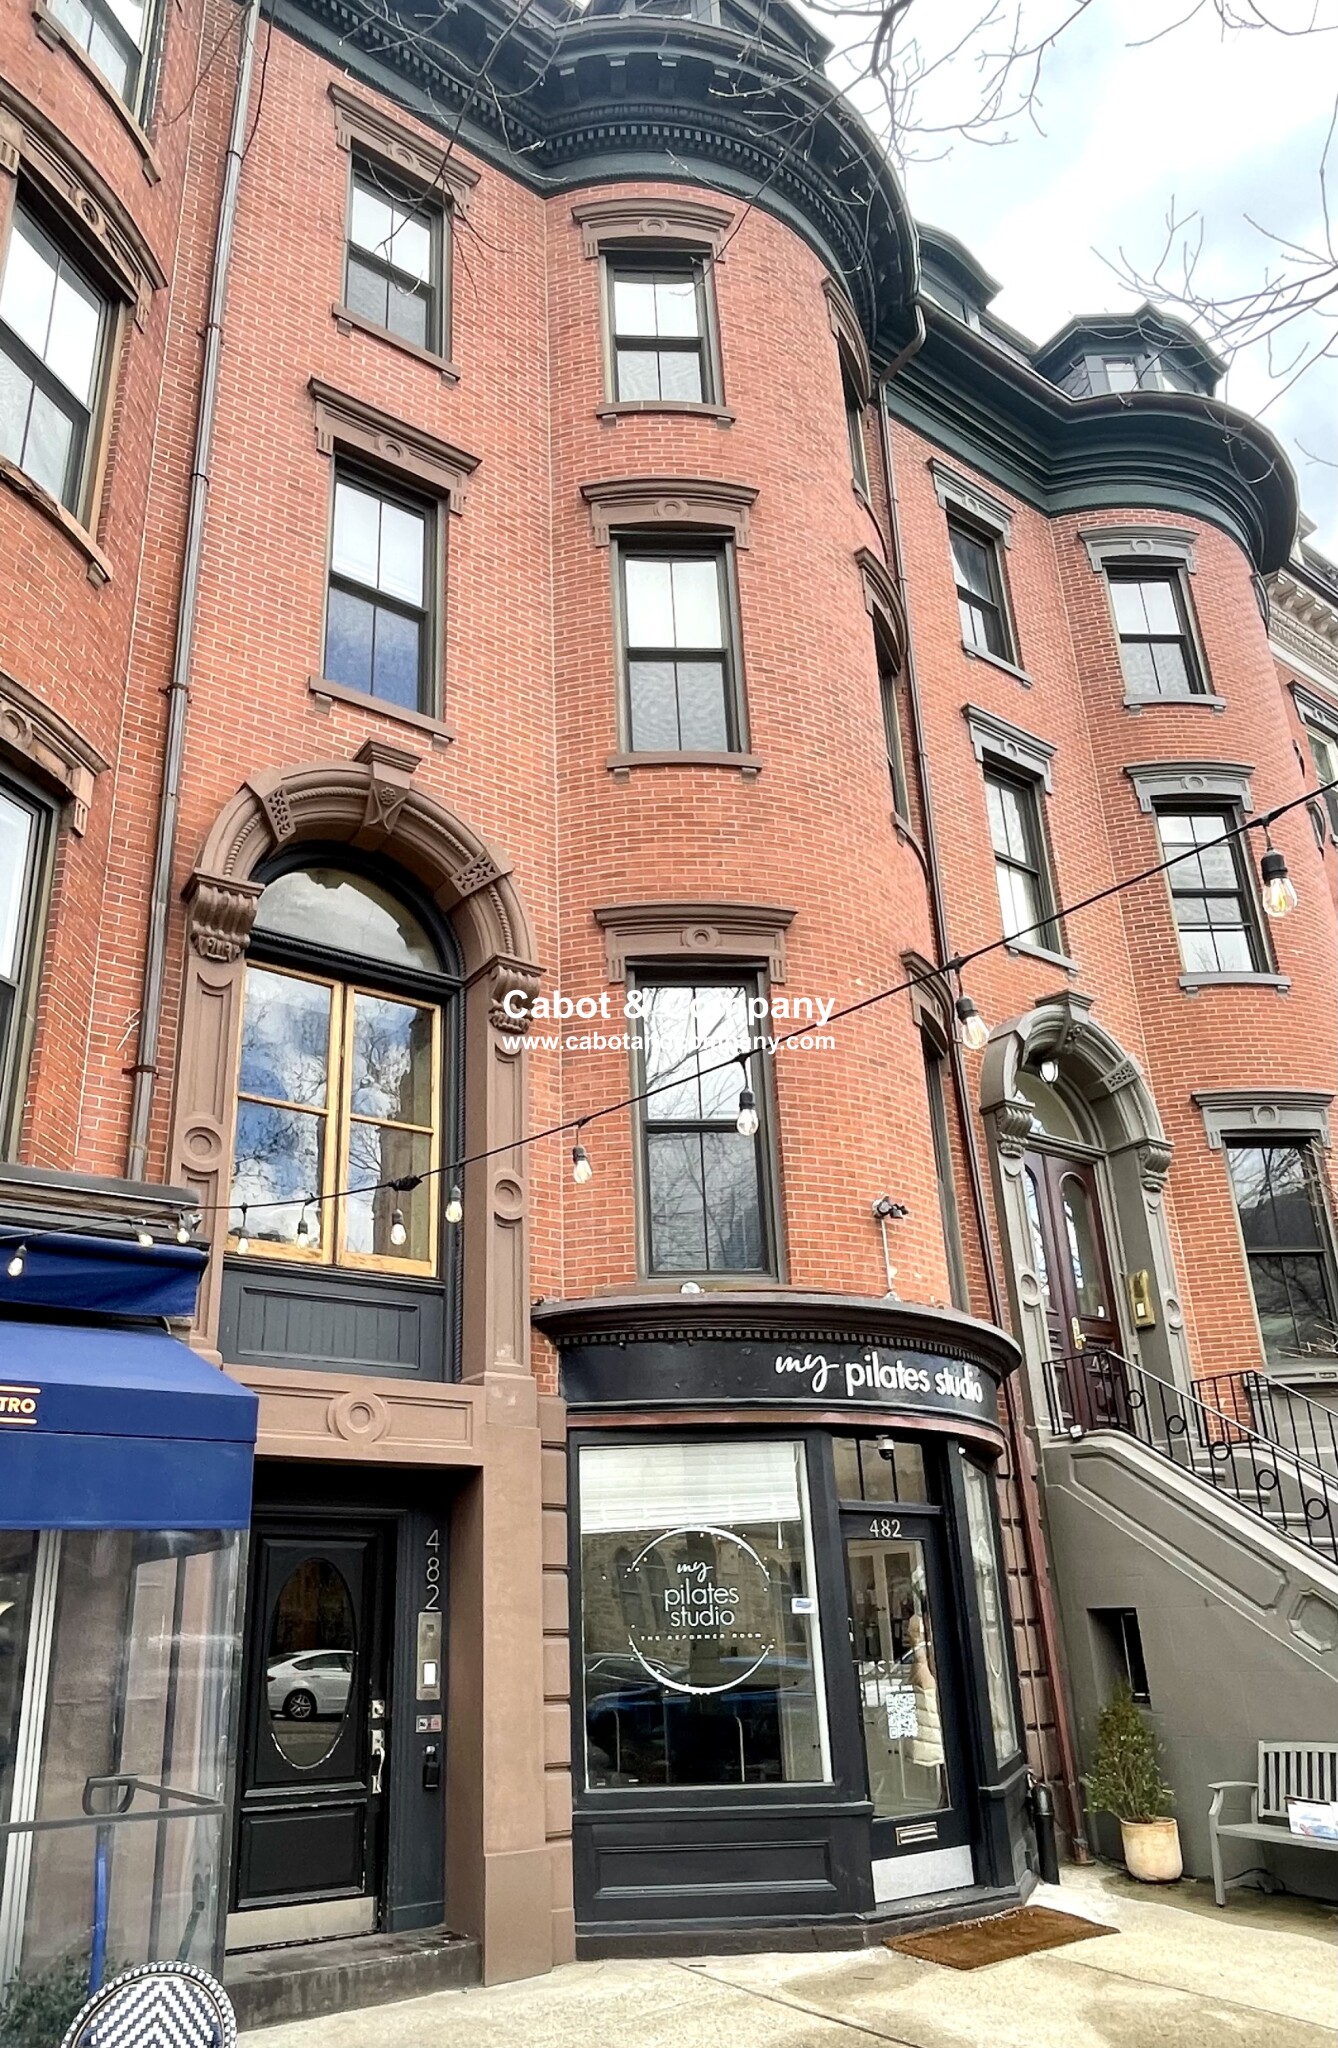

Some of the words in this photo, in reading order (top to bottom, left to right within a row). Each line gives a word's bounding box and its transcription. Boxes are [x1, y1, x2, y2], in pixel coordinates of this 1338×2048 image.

[775, 1353, 840, 1393] my
[845, 1351, 931, 1397] pilates
[935, 1365, 983, 1403] studio
[869, 1519, 902, 1538] 482
[425, 1529, 441, 1610] 482
[676, 1561, 714, 1583] my
[664, 1577, 740, 1612] pilates
[670, 1604, 735, 1627] studio
